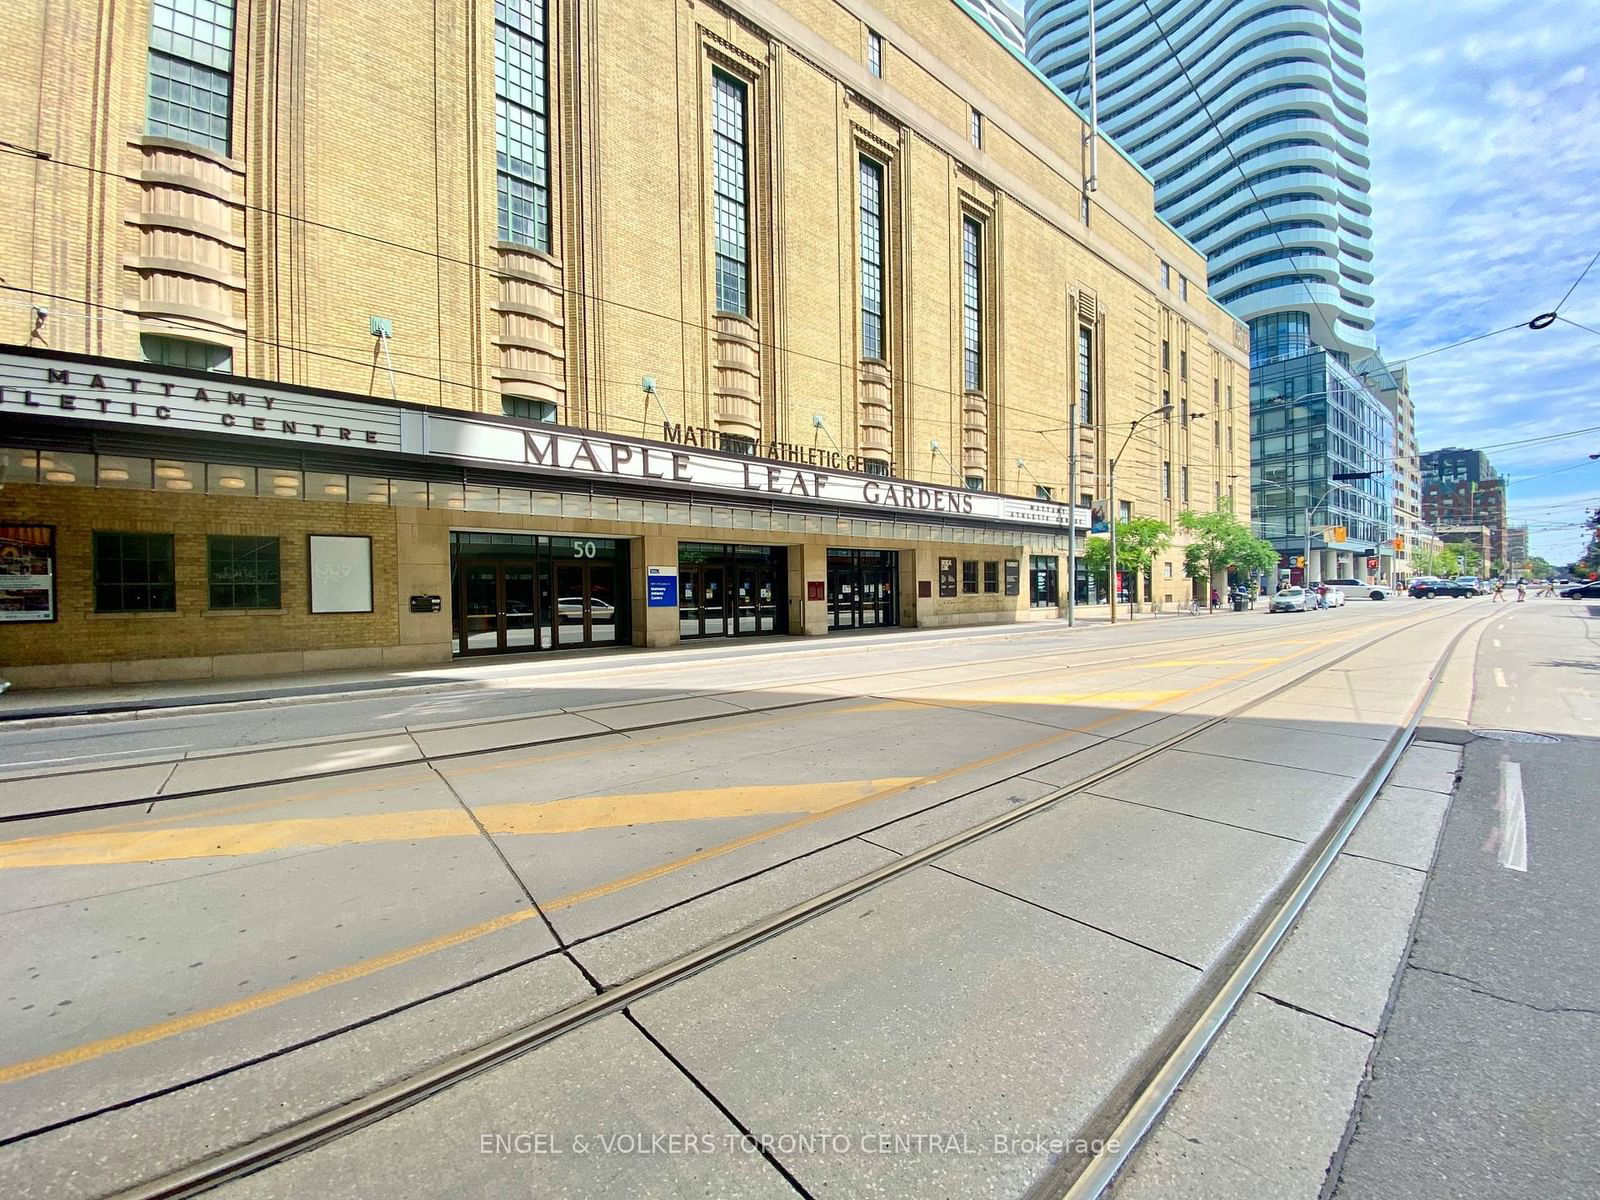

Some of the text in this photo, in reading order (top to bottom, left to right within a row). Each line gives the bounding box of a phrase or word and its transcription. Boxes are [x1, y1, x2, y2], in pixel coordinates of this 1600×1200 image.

[49, 367, 275, 411] MATTAMY
[221, 413, 378, 444] CENTRE
[767, 441, 841, 469] ATHLETIC
[523, 430, 973, 514] MAPLE LEAF GARDENS
[573, 540, 597, 559] 50
